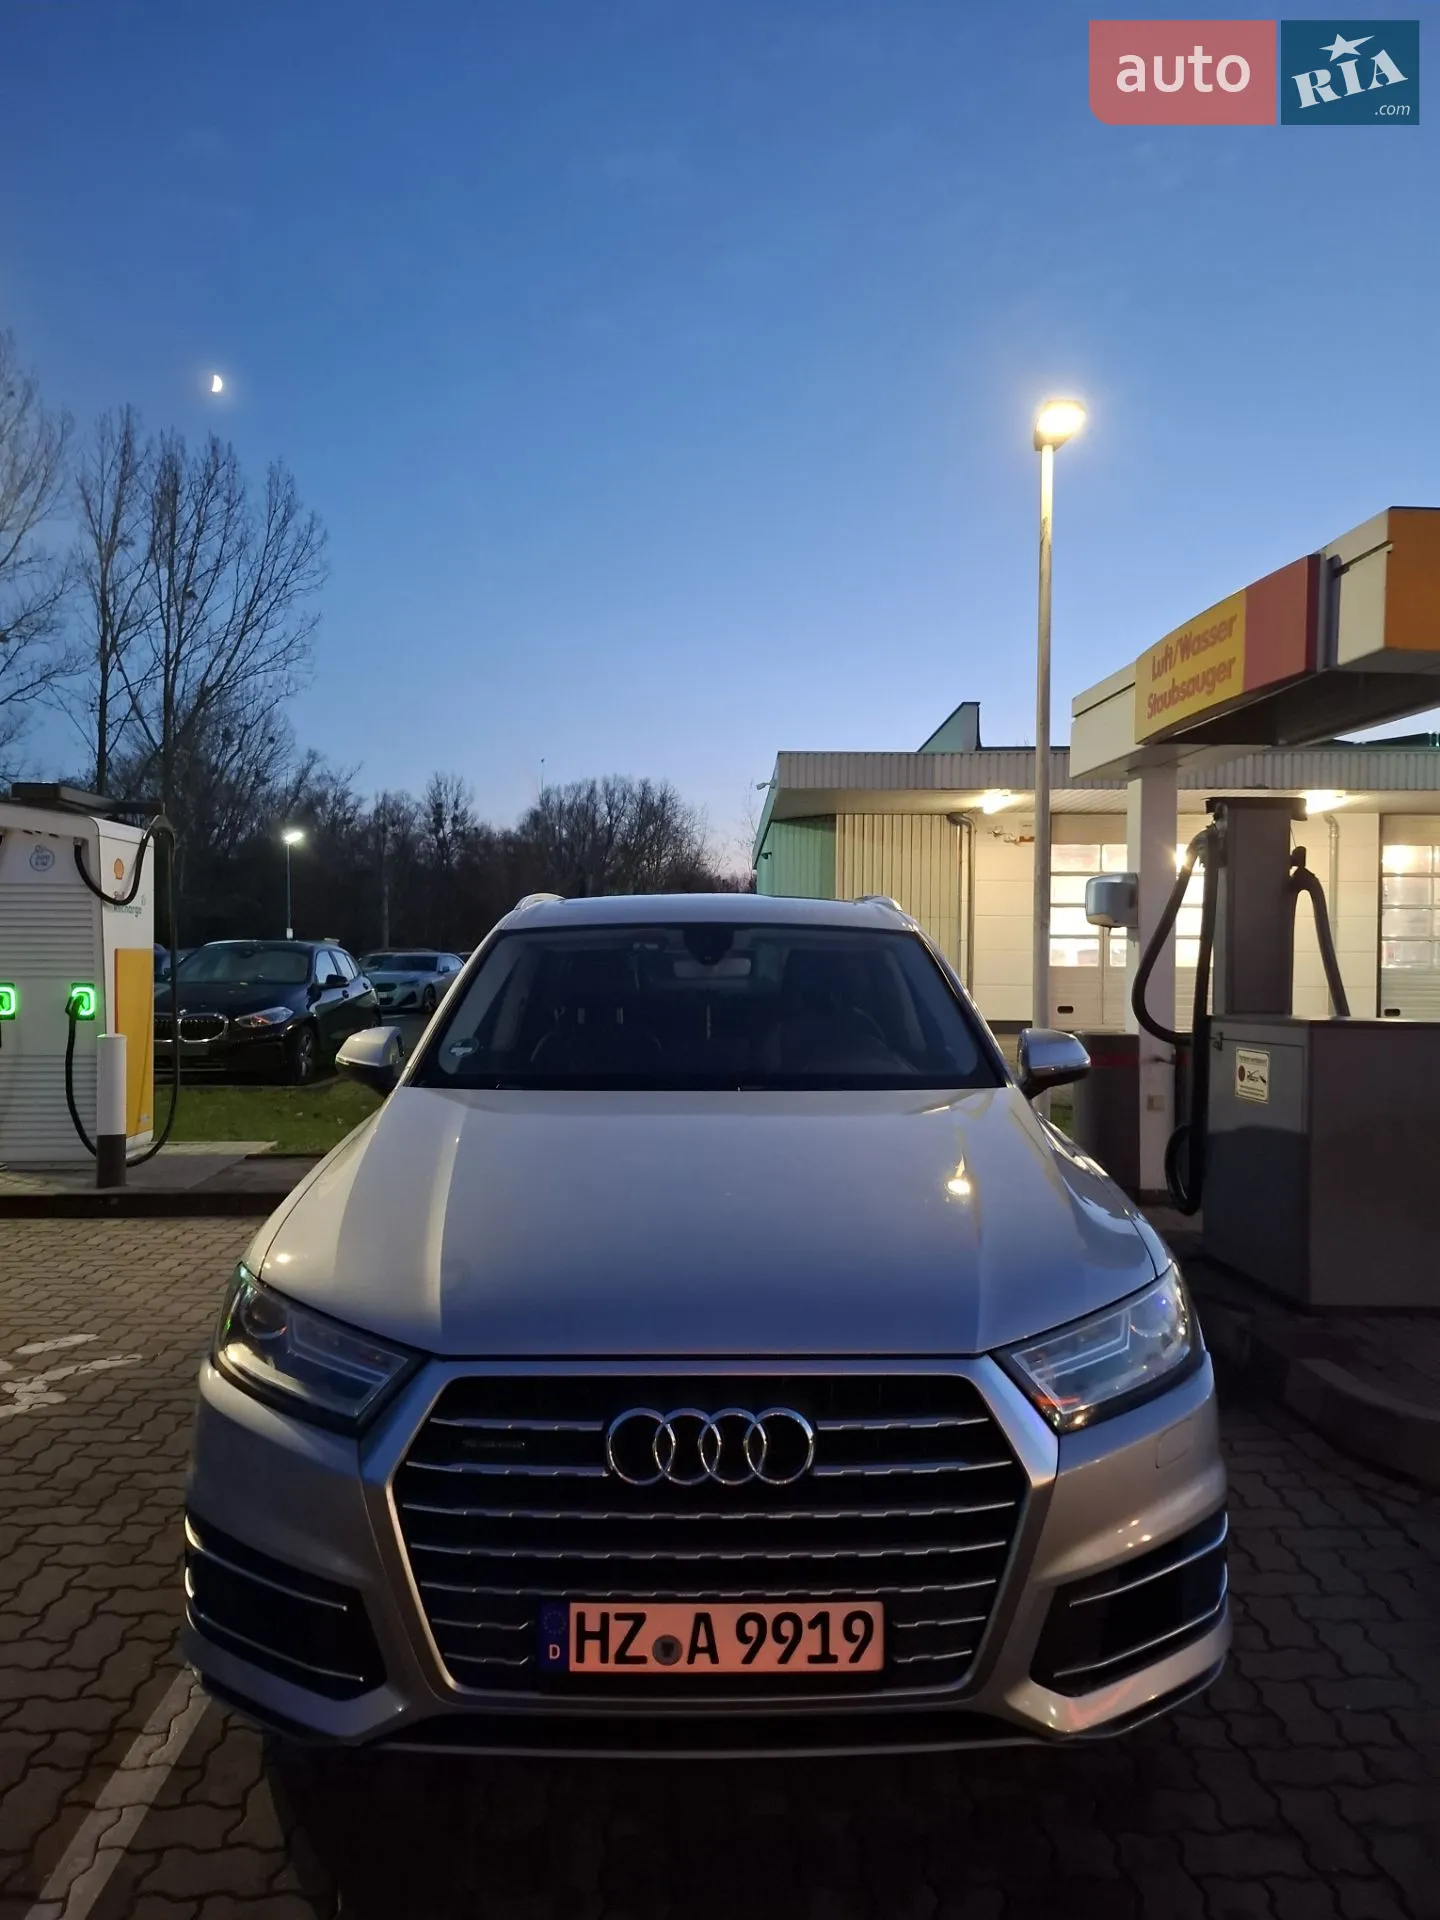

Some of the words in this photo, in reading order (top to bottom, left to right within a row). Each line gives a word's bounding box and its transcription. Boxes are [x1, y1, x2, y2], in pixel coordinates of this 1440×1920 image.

[1151, 613, 1238, 682] Luft/Wasser
[1147, 656, 1237, 720] Staubsauger
[548, 1645, 560, 1659] D
[575, 1611, 648, 1665] HZ
[686, 1612, 720, 1665] A
[735, 1610, 875, 1665] 9919
